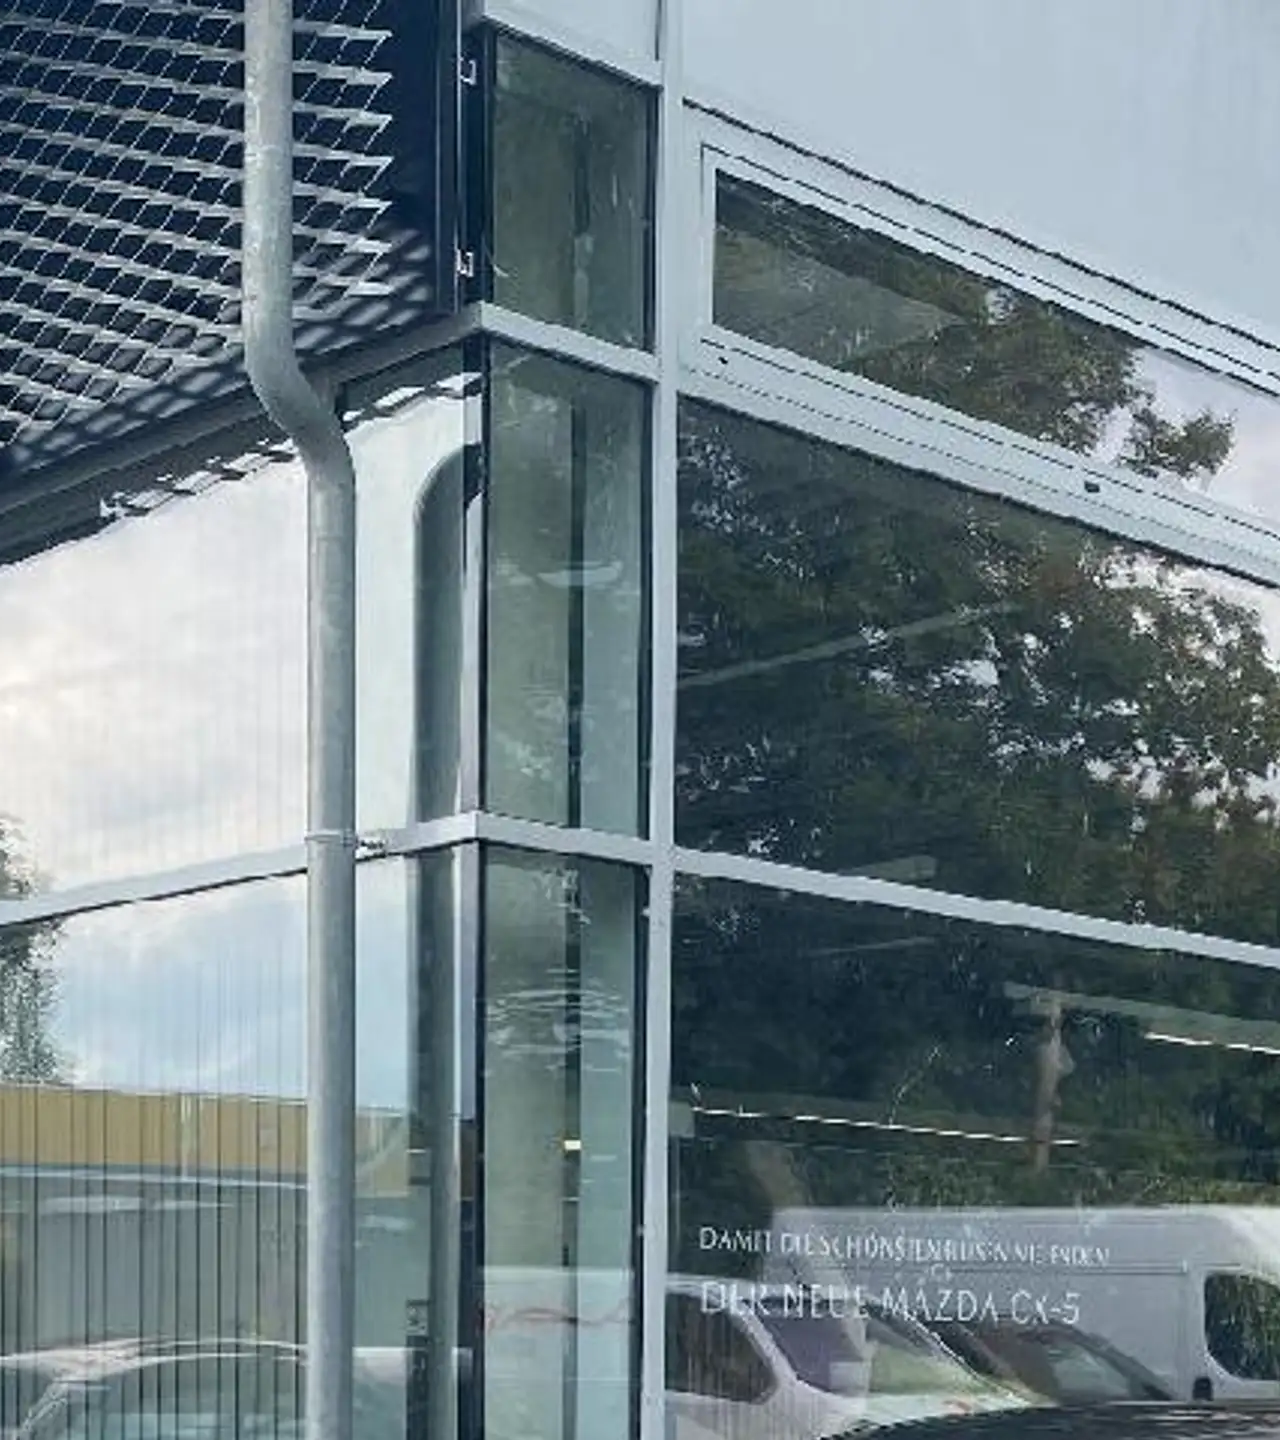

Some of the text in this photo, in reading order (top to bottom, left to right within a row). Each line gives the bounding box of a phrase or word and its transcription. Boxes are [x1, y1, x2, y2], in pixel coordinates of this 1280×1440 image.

[699, 1226, 771, 1252] DAMIT
[701, 1281, 771, 1316] DER
[783, 1282, 869, 1319] NEUE
[881, 1286, 999, 1323] MAZDA
